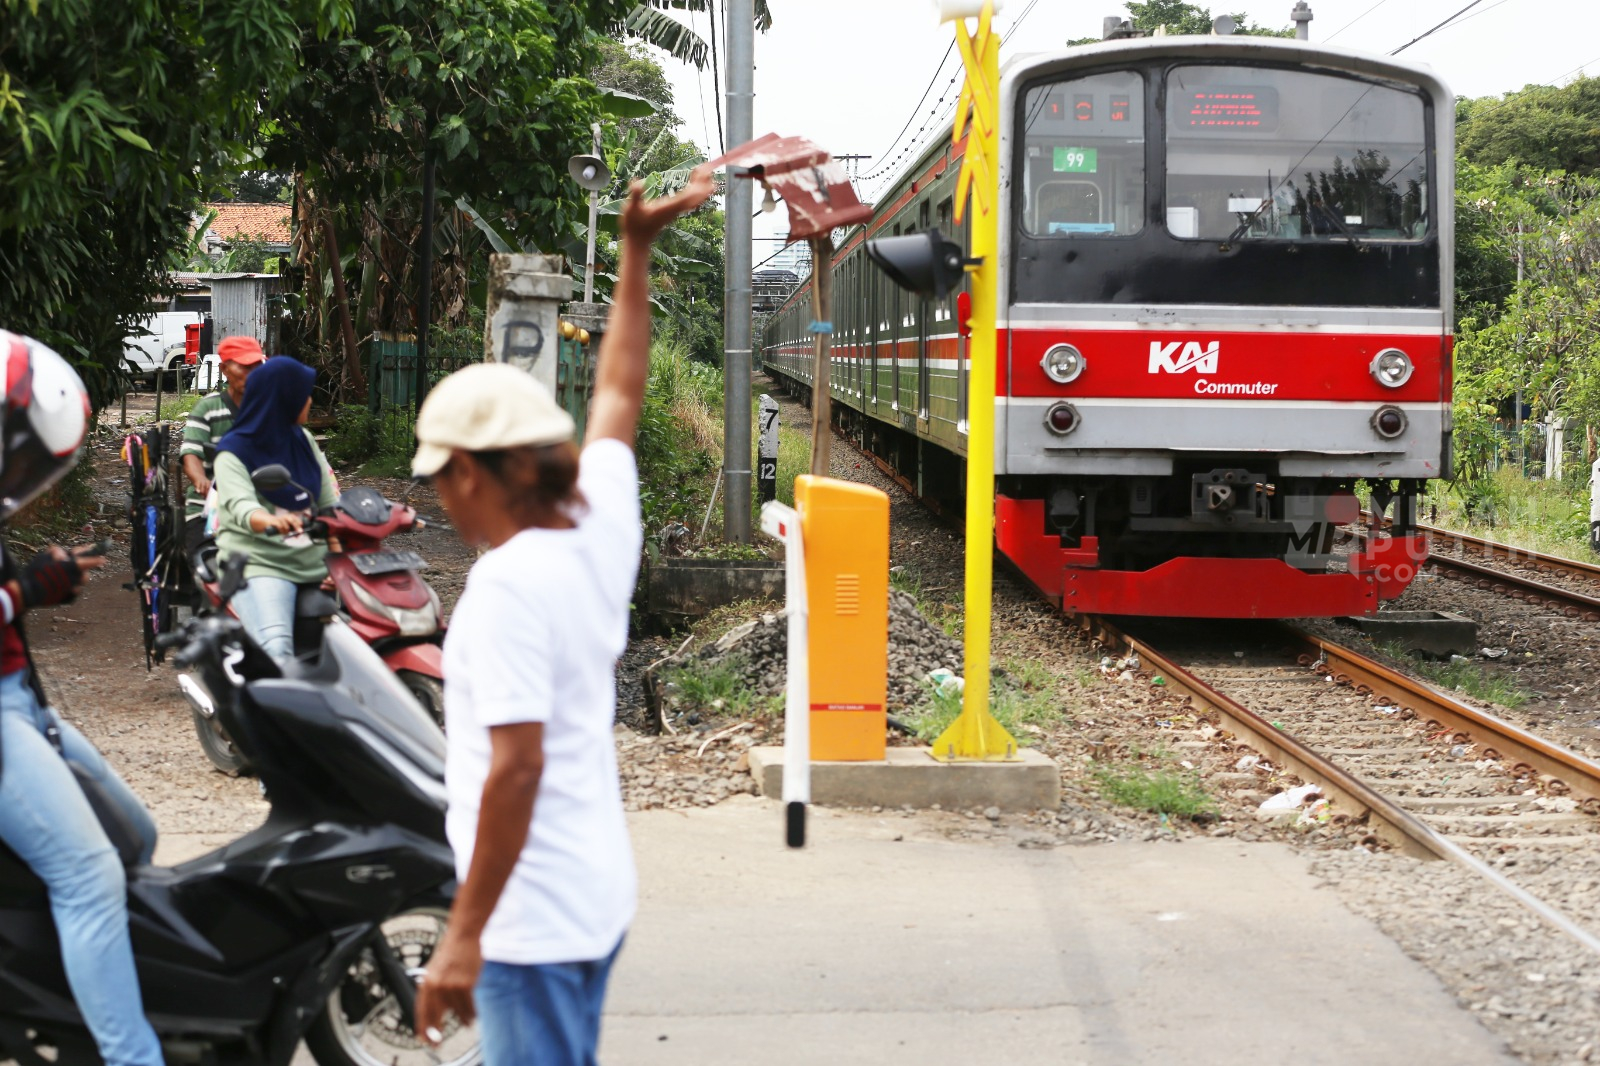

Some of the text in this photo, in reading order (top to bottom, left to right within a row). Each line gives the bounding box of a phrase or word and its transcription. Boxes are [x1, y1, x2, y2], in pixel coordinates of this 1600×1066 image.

[1066, 152, 1085, 168] 99
[1148, 340, 1220, 374] KAI
[1194, 379, 1279, 395] Commuter
[765, 408, 779, 431] 7
[760, 463, 776, 480] 12
